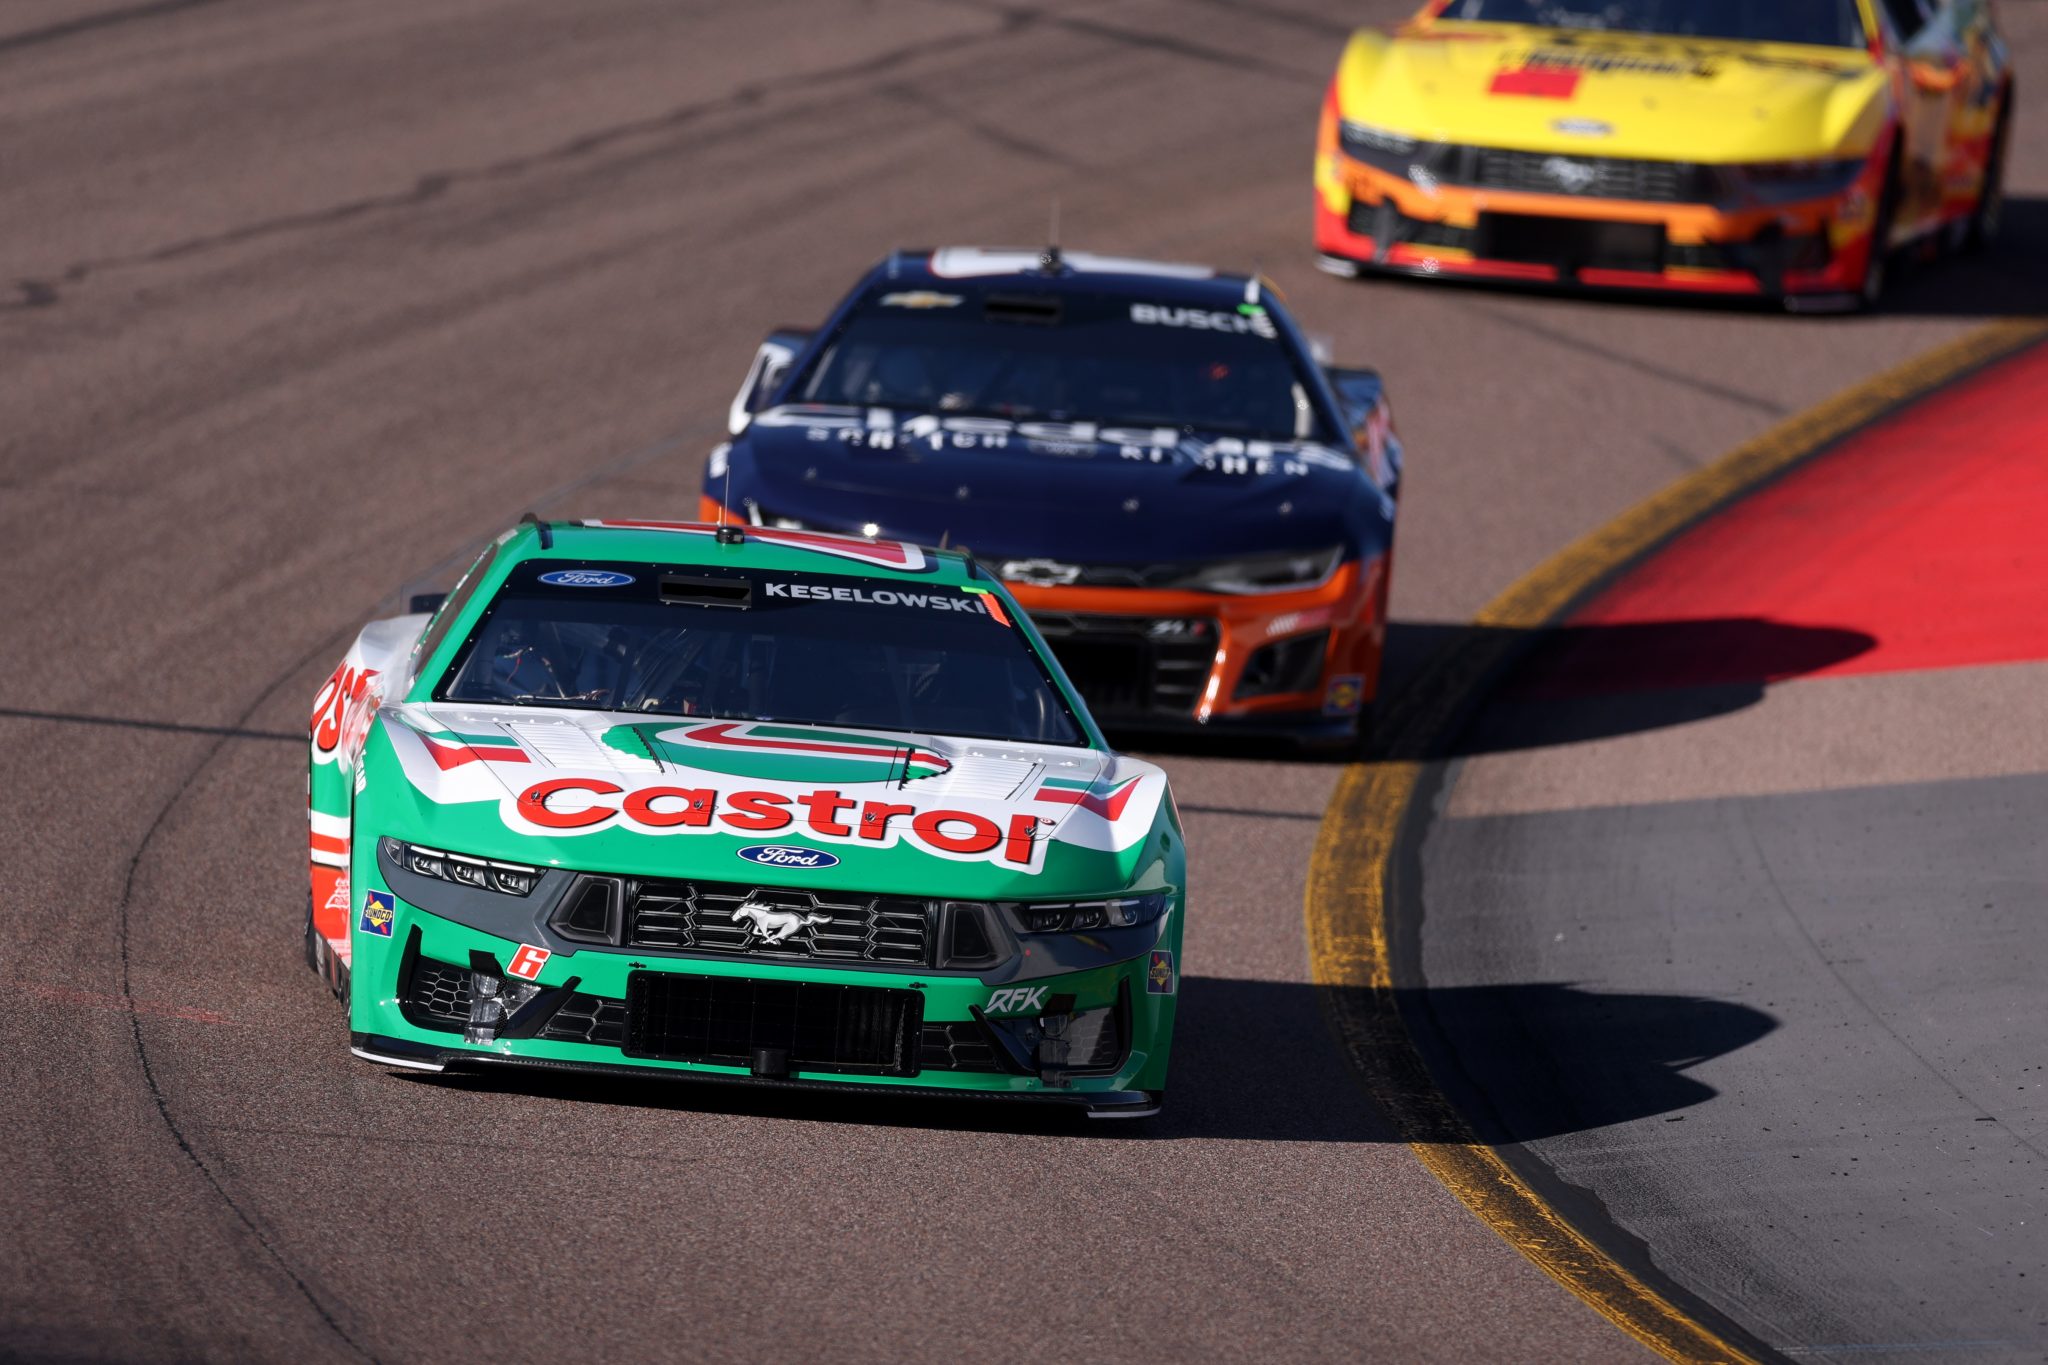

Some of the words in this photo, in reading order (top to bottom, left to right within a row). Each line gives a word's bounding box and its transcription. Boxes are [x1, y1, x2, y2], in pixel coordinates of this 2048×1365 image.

[557, 572, 616, 584] Ford
[765, 583, 988, 614] KESELOWSKI
[516, 777, 1039, 864] Castrol
[757, 847, 820, 865] Ford
[507, 944, 551, 981] 6
[984, 986, 1049, 1014] RFK
